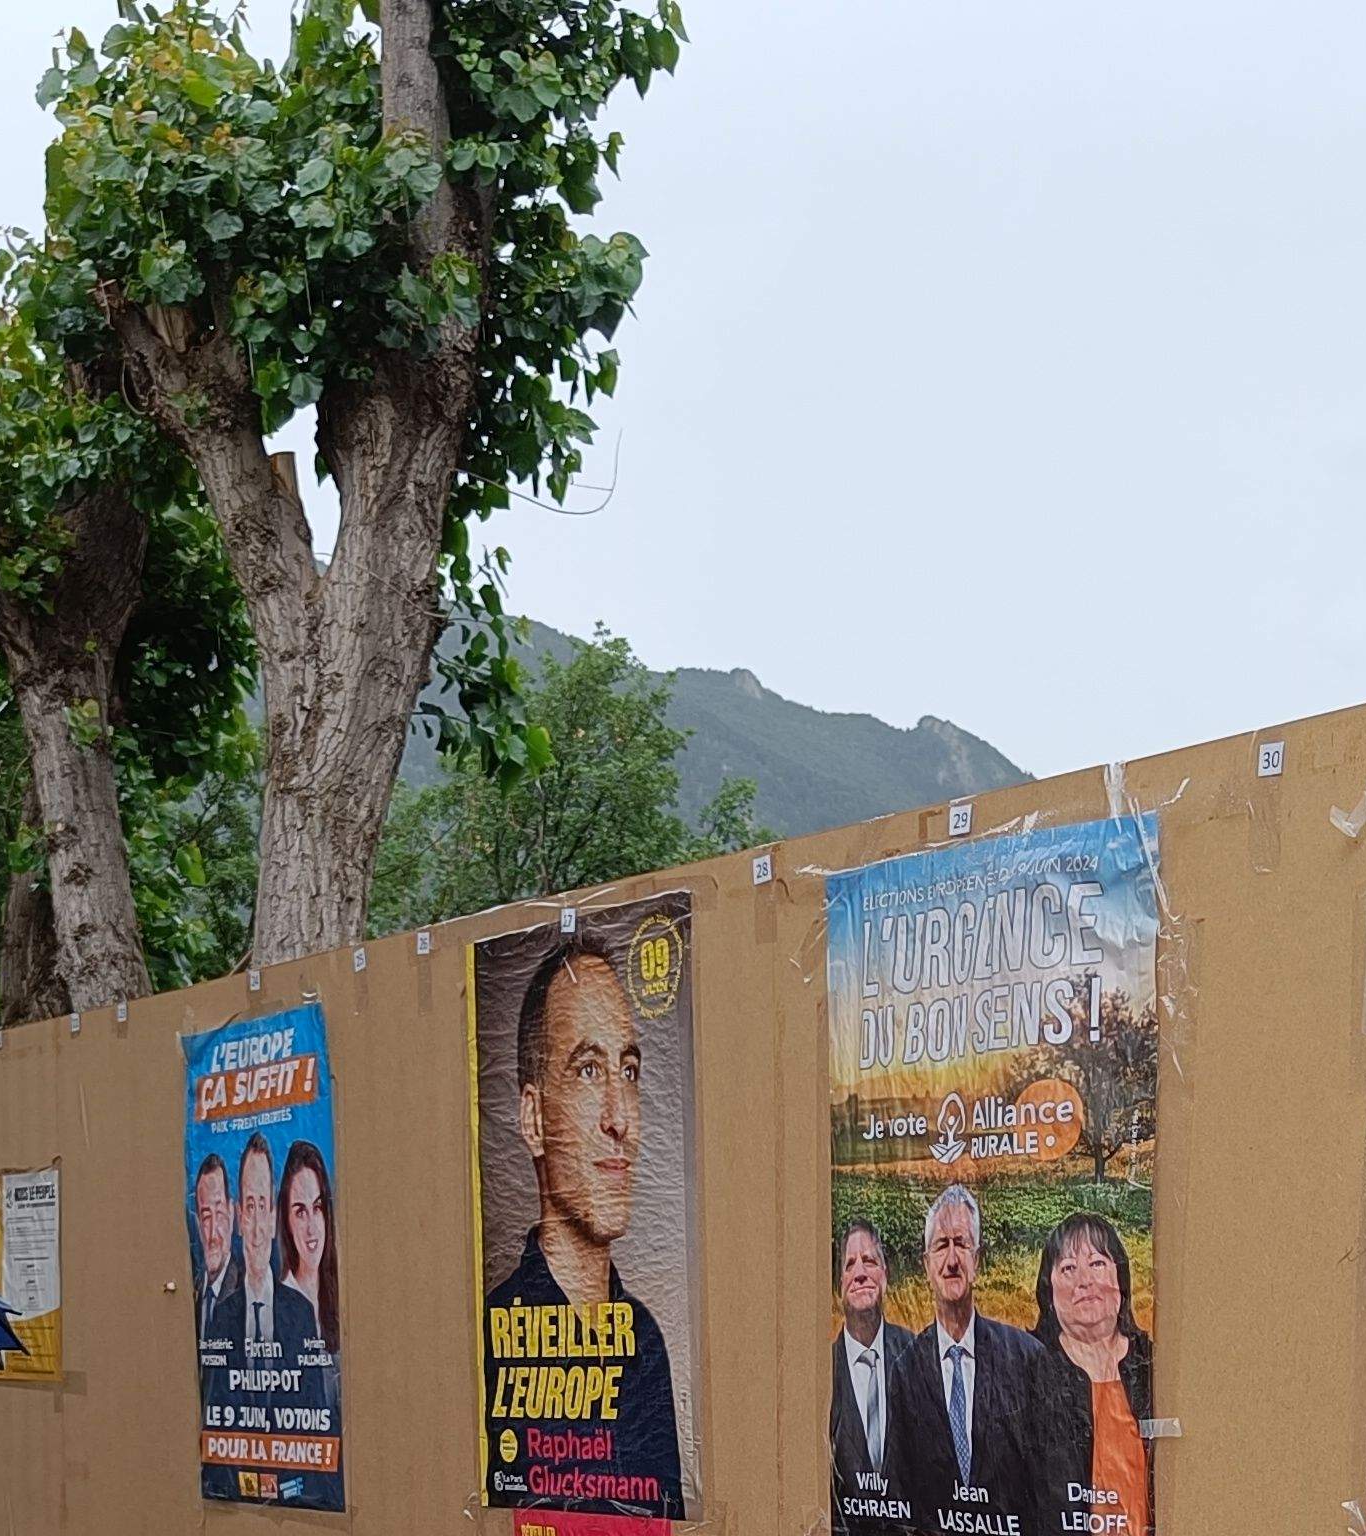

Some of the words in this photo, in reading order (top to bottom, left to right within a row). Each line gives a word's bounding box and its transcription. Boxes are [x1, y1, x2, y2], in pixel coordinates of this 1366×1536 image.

[1262, 750, 1280, 770] 30
[953, 811, 968, 830] 29
[756, 861, 769, 879] 28
[863, 886, 924, 912] ELECTIONS
[1065, 855, 1099, 873] 2024
[862, 881, 1104, 999] L'URGENCE
[859, 1005, 894, 1070] DU
[903, 993, 967, 1065] BON
[973, 977, 1074, 1054] SENS
[210, 1027, 295, 1074] L'EUROPE
[201, 1076, 227, 1120] ÇA
[232, 1060, 301, 1106] SUFFIT
[862, 1114, 884, 1140] Je
[886, 1112, 927, 1137] vote
[971, 1096, 1074, 1130] Alliance
[970, 1131, 1039, 1160] RURALE
[489, 1296, 636, 1359] RÉVEILLER
[244, 1336, 283, 1358] Florian
[229, 1369, 302, 1393] PHILIPPOT
[491, 1365, 623, 1421] L'EUROPE
[206, 1405, 221, 1427] LE
[224, 1405, 235, 1427] 9
[238, 1406, 271, 1433] JUIN,
[273, 1407, 331, 1431] VOTONS
[208, 1437, 249, 1459] POUR
[251, 1439, 268, 1461] LA
[271, 1440, 323, 1464] FRANCE
[526, 1428, 612, 1466] Raphaël
[529, 1464, 659, 1501] Glucksmann
[855, 1472, 889, 1496] Willy
[952, 1479, 990, 1504] Jean
[843, 1497, 912, 1520] SCHRAEN
[937, 1508, 1021, 1536] LASSALLE
